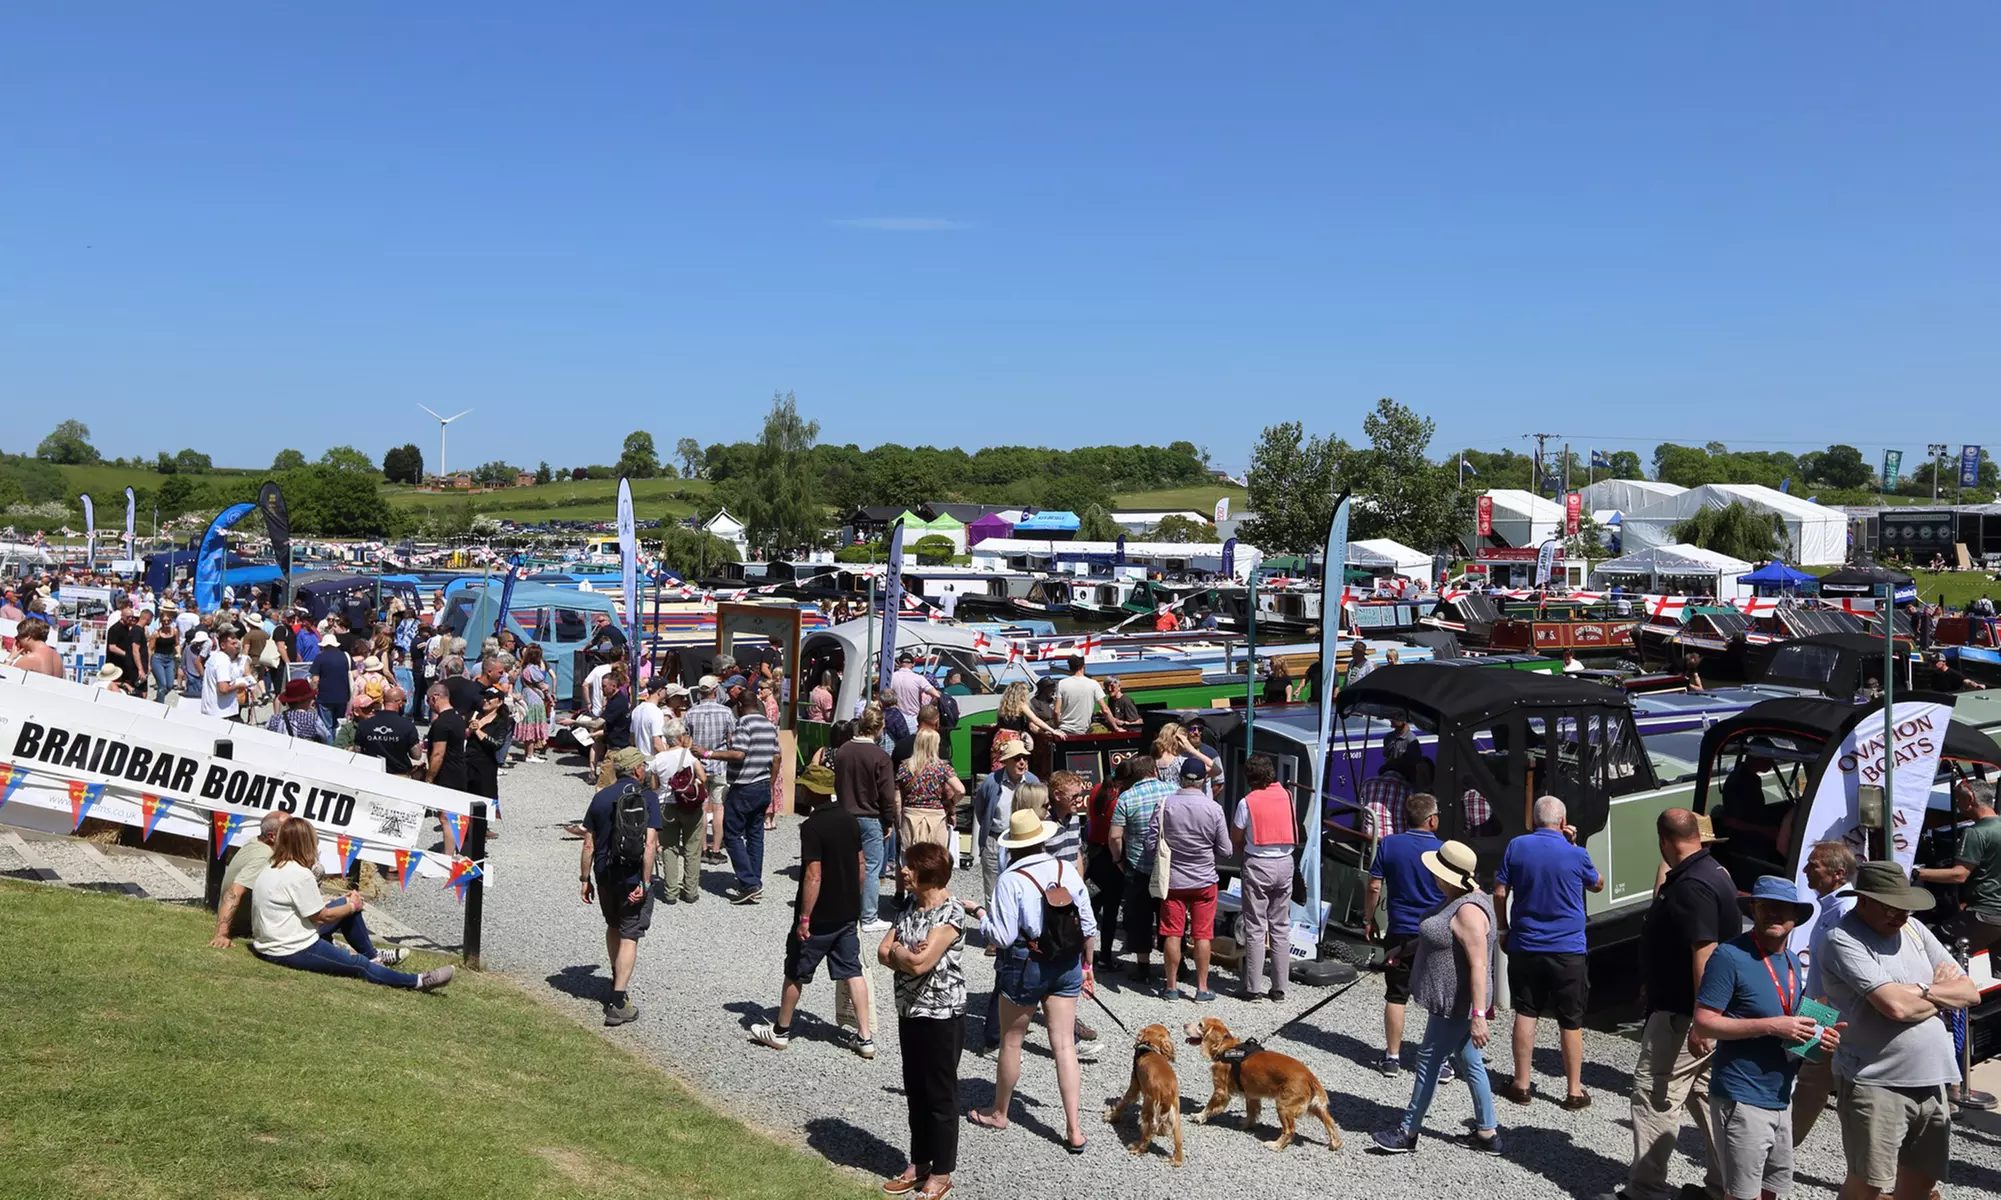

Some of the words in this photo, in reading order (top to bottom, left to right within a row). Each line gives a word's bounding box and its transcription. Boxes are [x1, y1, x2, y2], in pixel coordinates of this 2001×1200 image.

[12, 721, 199, 793] BRAIDBAR
[200, 764, 301, 814] BOATS
[303, 787, 356, 827] LTD
[1861, 737, 1935, 783] BOATS
